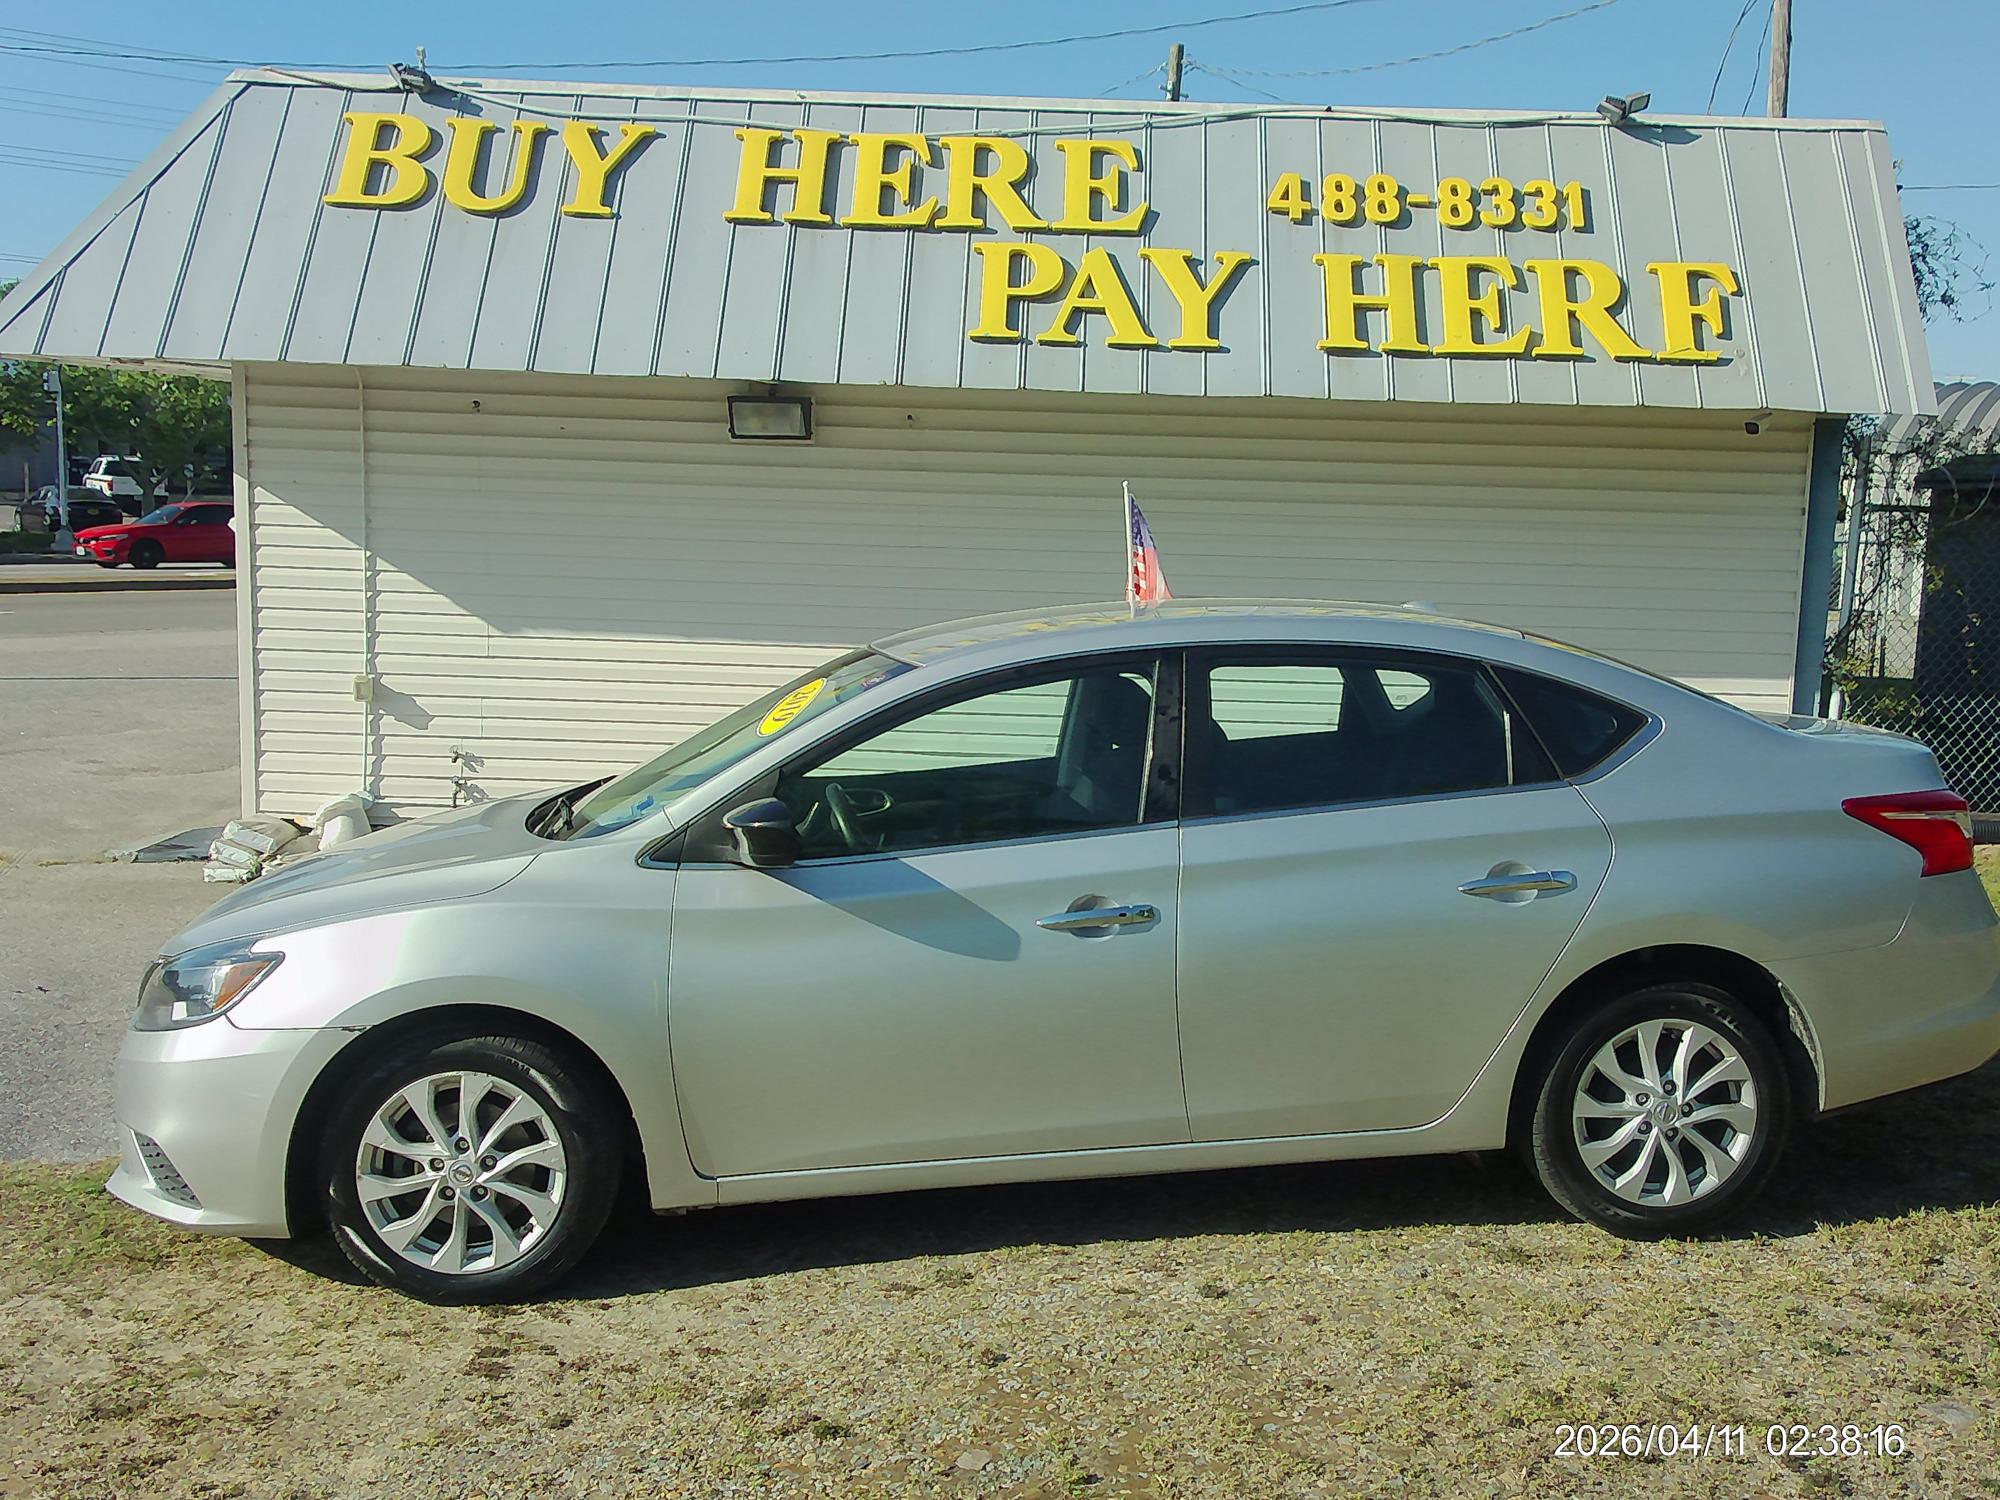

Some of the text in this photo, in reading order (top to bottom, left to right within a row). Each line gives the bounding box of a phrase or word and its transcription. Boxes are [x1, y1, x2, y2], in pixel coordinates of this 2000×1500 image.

[324, 111, 1149, 232] BUY HERE
[1267, 171, 1585, 230] 488-8331
[969, 241, 1739, 361] PAY HERE
